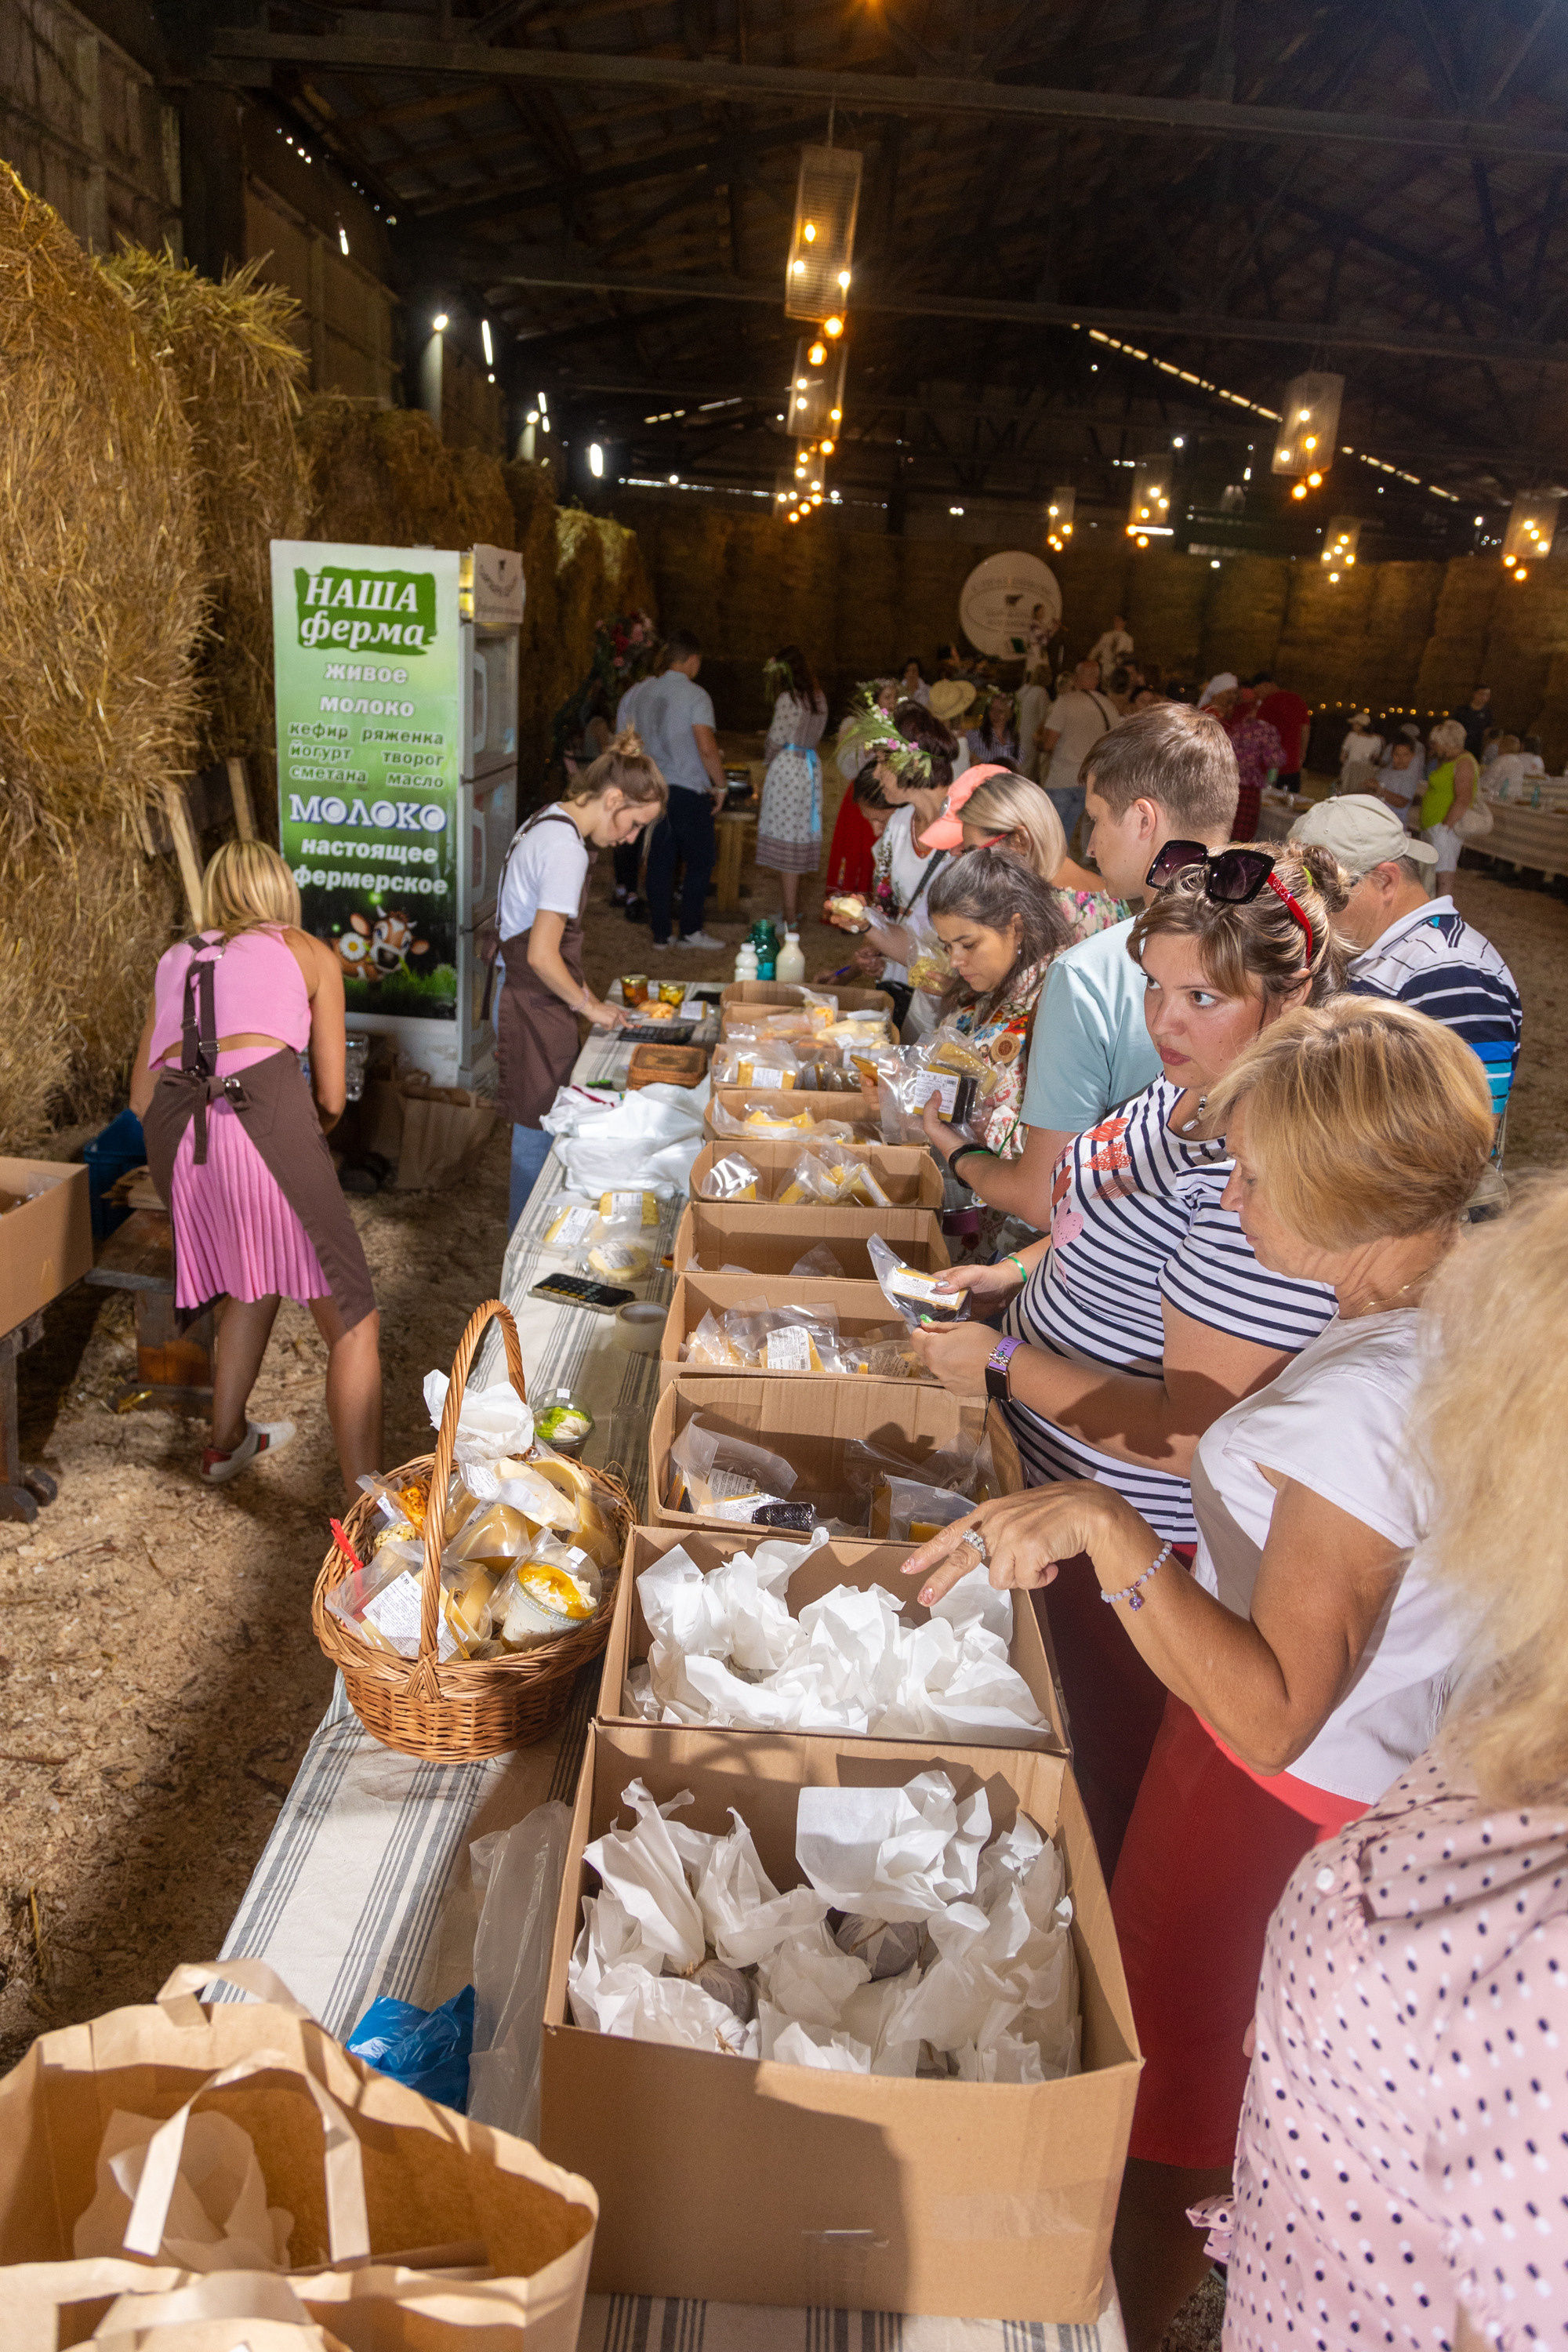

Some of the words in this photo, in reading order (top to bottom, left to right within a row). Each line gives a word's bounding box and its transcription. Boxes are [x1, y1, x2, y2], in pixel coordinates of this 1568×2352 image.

[303, 576, 419, 613] НАША
[300, 610, 425, 650] ферма
[324, 662, 408, 684] живое
[319, 695, 415, 717] молоко
[289, 721, 349, 740] кефир
[361, 728, 444, 745] ряженка
[290, 741, 351, 761] йогурт
[383, 750, 445, 768] творог
[290, 765, 367, 783] сметана
[387, 772, 445, 788] масло
[289, 793, 447, 833] МОЛОКО
[300, 838, 439, 866] настоящее
[292, 864, 448, 895] фермерское
